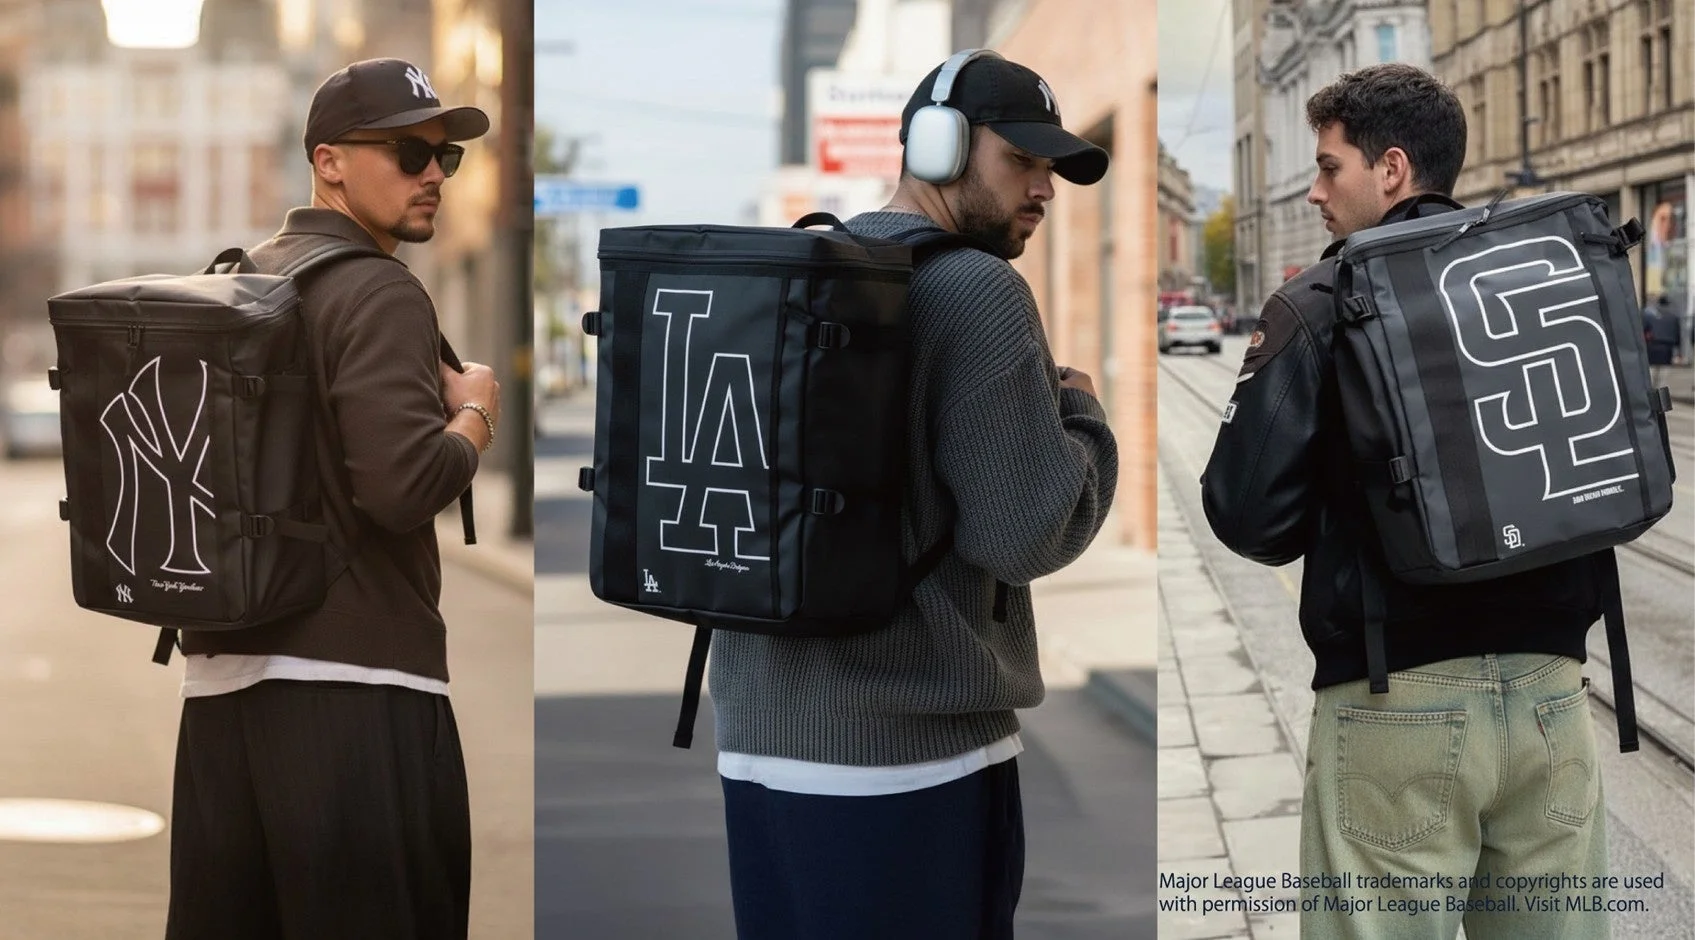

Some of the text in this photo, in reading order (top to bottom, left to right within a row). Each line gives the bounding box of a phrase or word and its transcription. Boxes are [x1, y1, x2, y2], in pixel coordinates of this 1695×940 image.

[646, 287, 771, 562] LA
[115, 583, 134, 603] NY
[643, 568, 660, 593] LA
